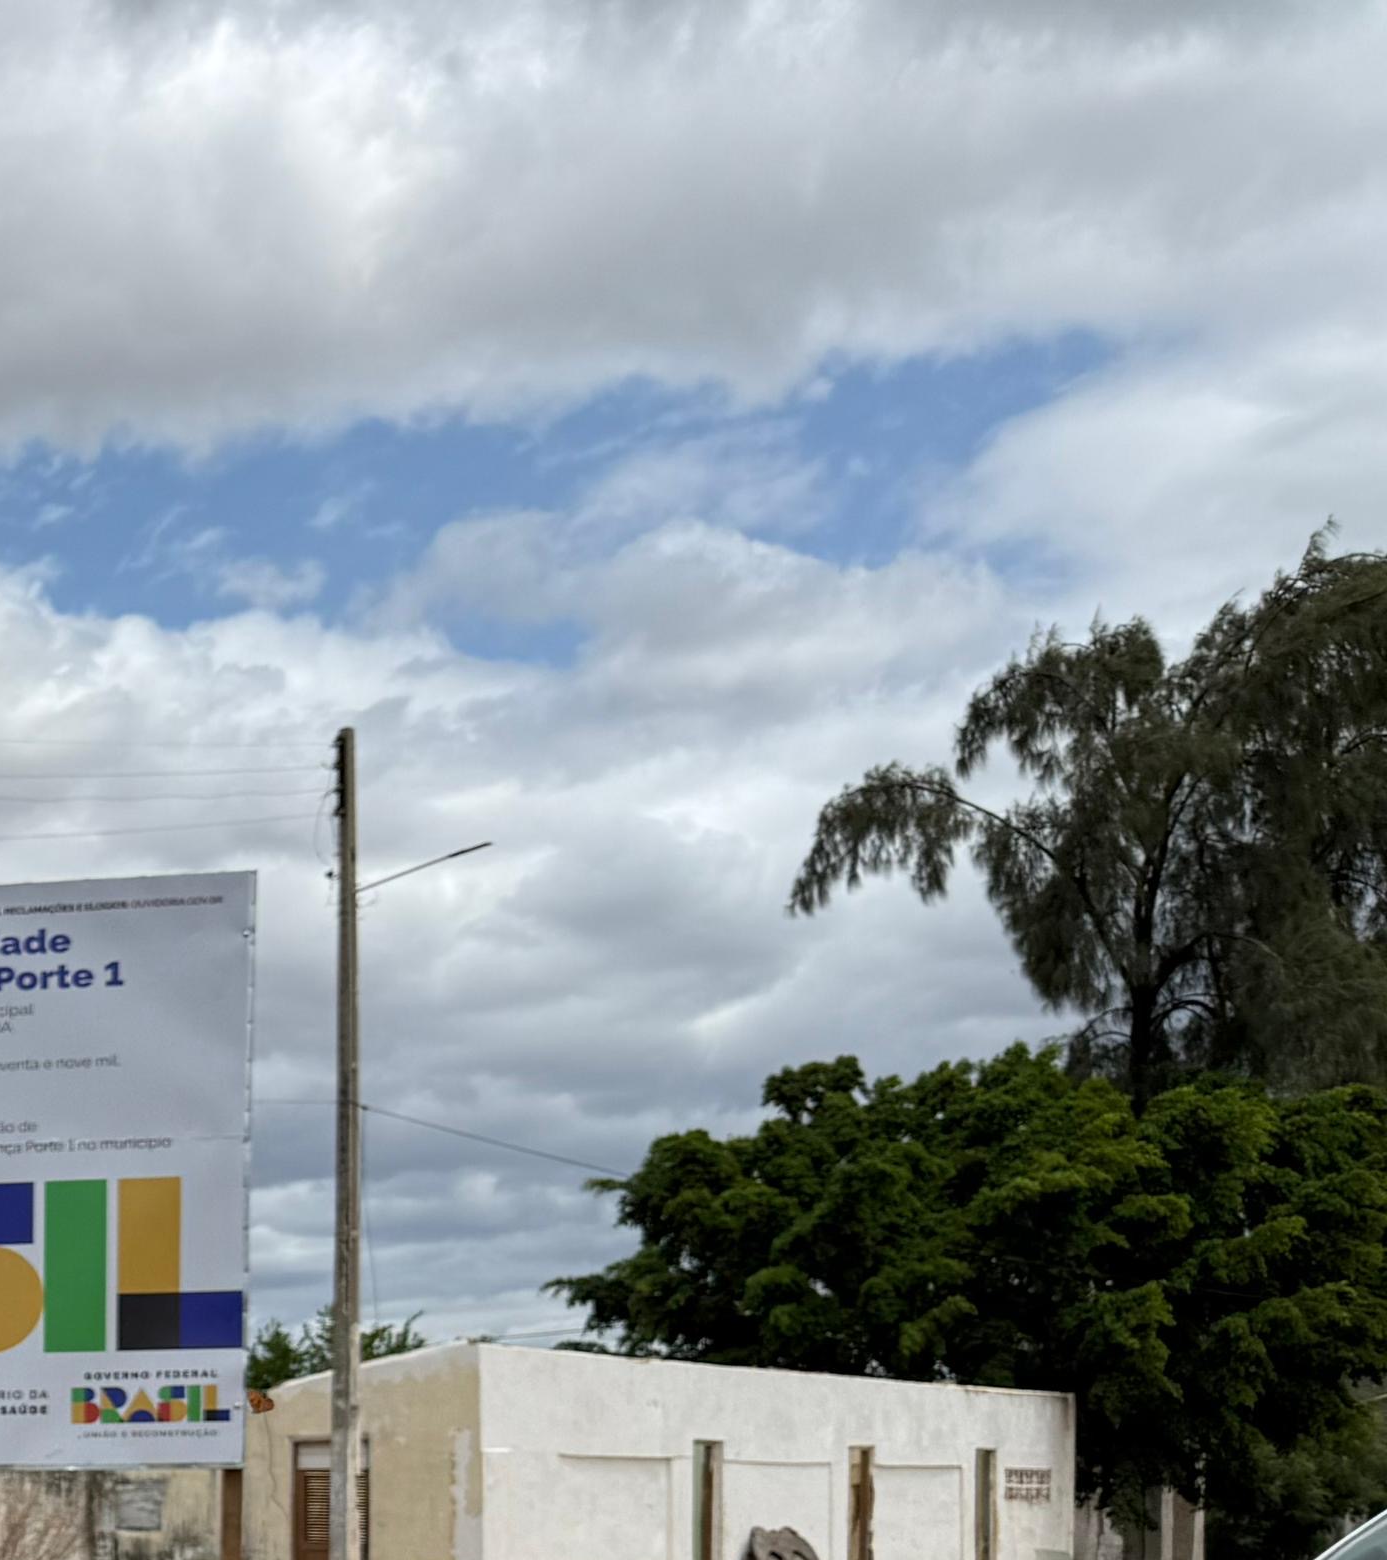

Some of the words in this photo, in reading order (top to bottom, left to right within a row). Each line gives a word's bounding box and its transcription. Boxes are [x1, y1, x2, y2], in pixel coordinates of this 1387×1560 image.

[104, 961, 124, 986] 1
[43, 1059, 53, 1069] e
[56, 1056, 92, 1069] nove
[18, 1121, 38, 1133] de
[25, 1139, 63, 1154] Porte
[77, 1139, 96, 1151] no
[83, 1370, 151, 1381] GOVERNO
[155, 1369, 219, 1380] FEDERAL
[29, 1388, 48, 1400] DA
[0, 1402, 48, 1415] SAÚDE
[70, 1383, 231, 1425] BRASIL
